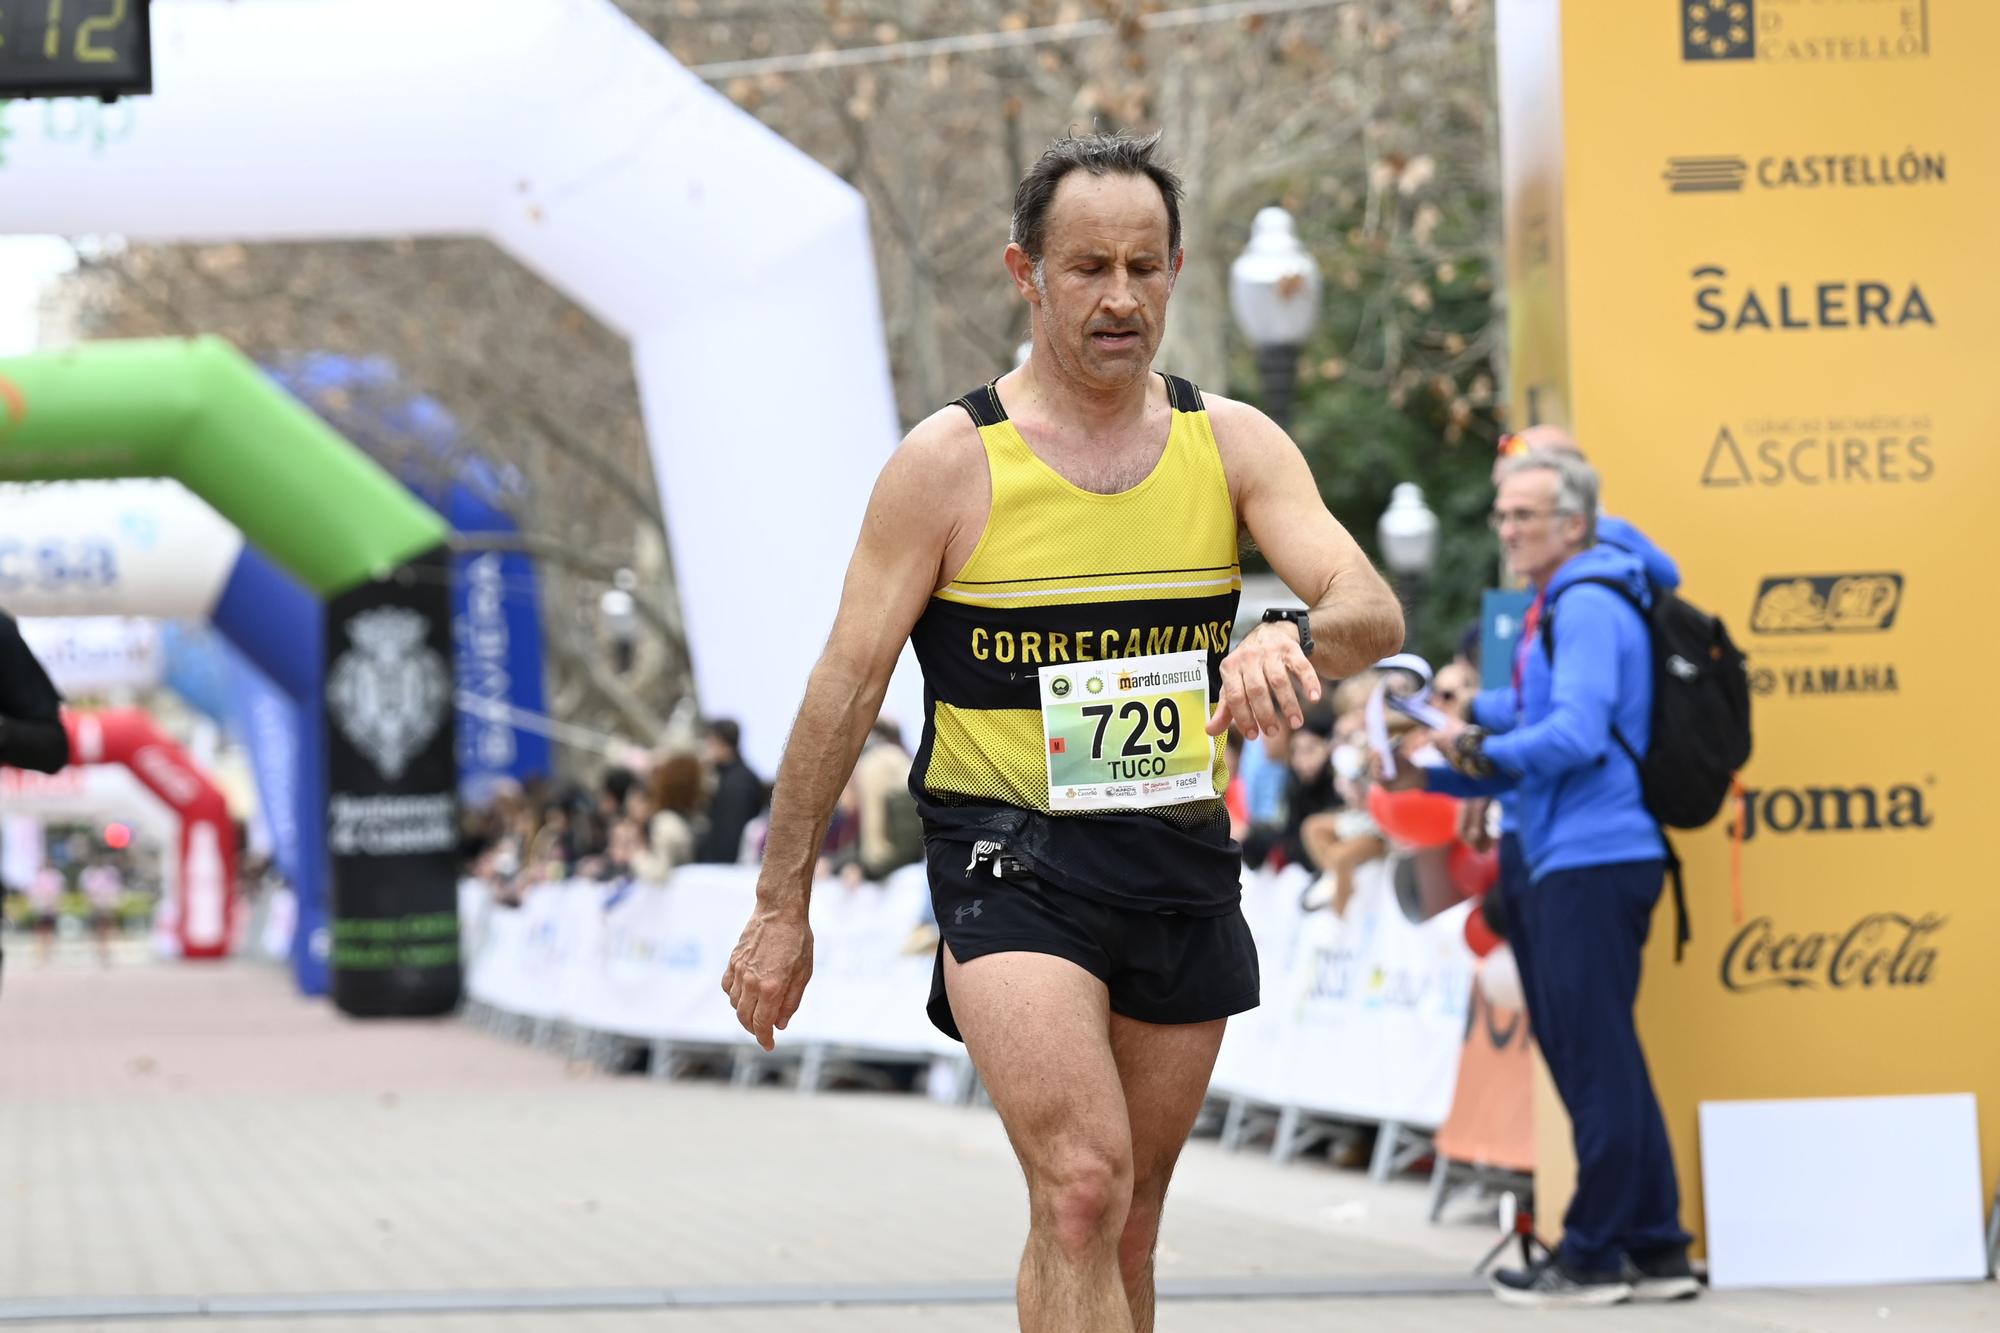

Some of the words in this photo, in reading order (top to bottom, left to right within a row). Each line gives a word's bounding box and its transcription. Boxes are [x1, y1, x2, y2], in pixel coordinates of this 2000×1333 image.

[1757, 148, 1946, 188] CASTELLÓN
[972, 620, 1231, 663] CORRECAMINOS
[1120, 672, 1160, 689] marató
[1162, 667, 1201, 685] CASTELLÓ
[1783, 665, 1899, 696] YAMAHA
[1081, 697, 1181, 760] 729
[1108, 756, 1166, 779] TUCO
